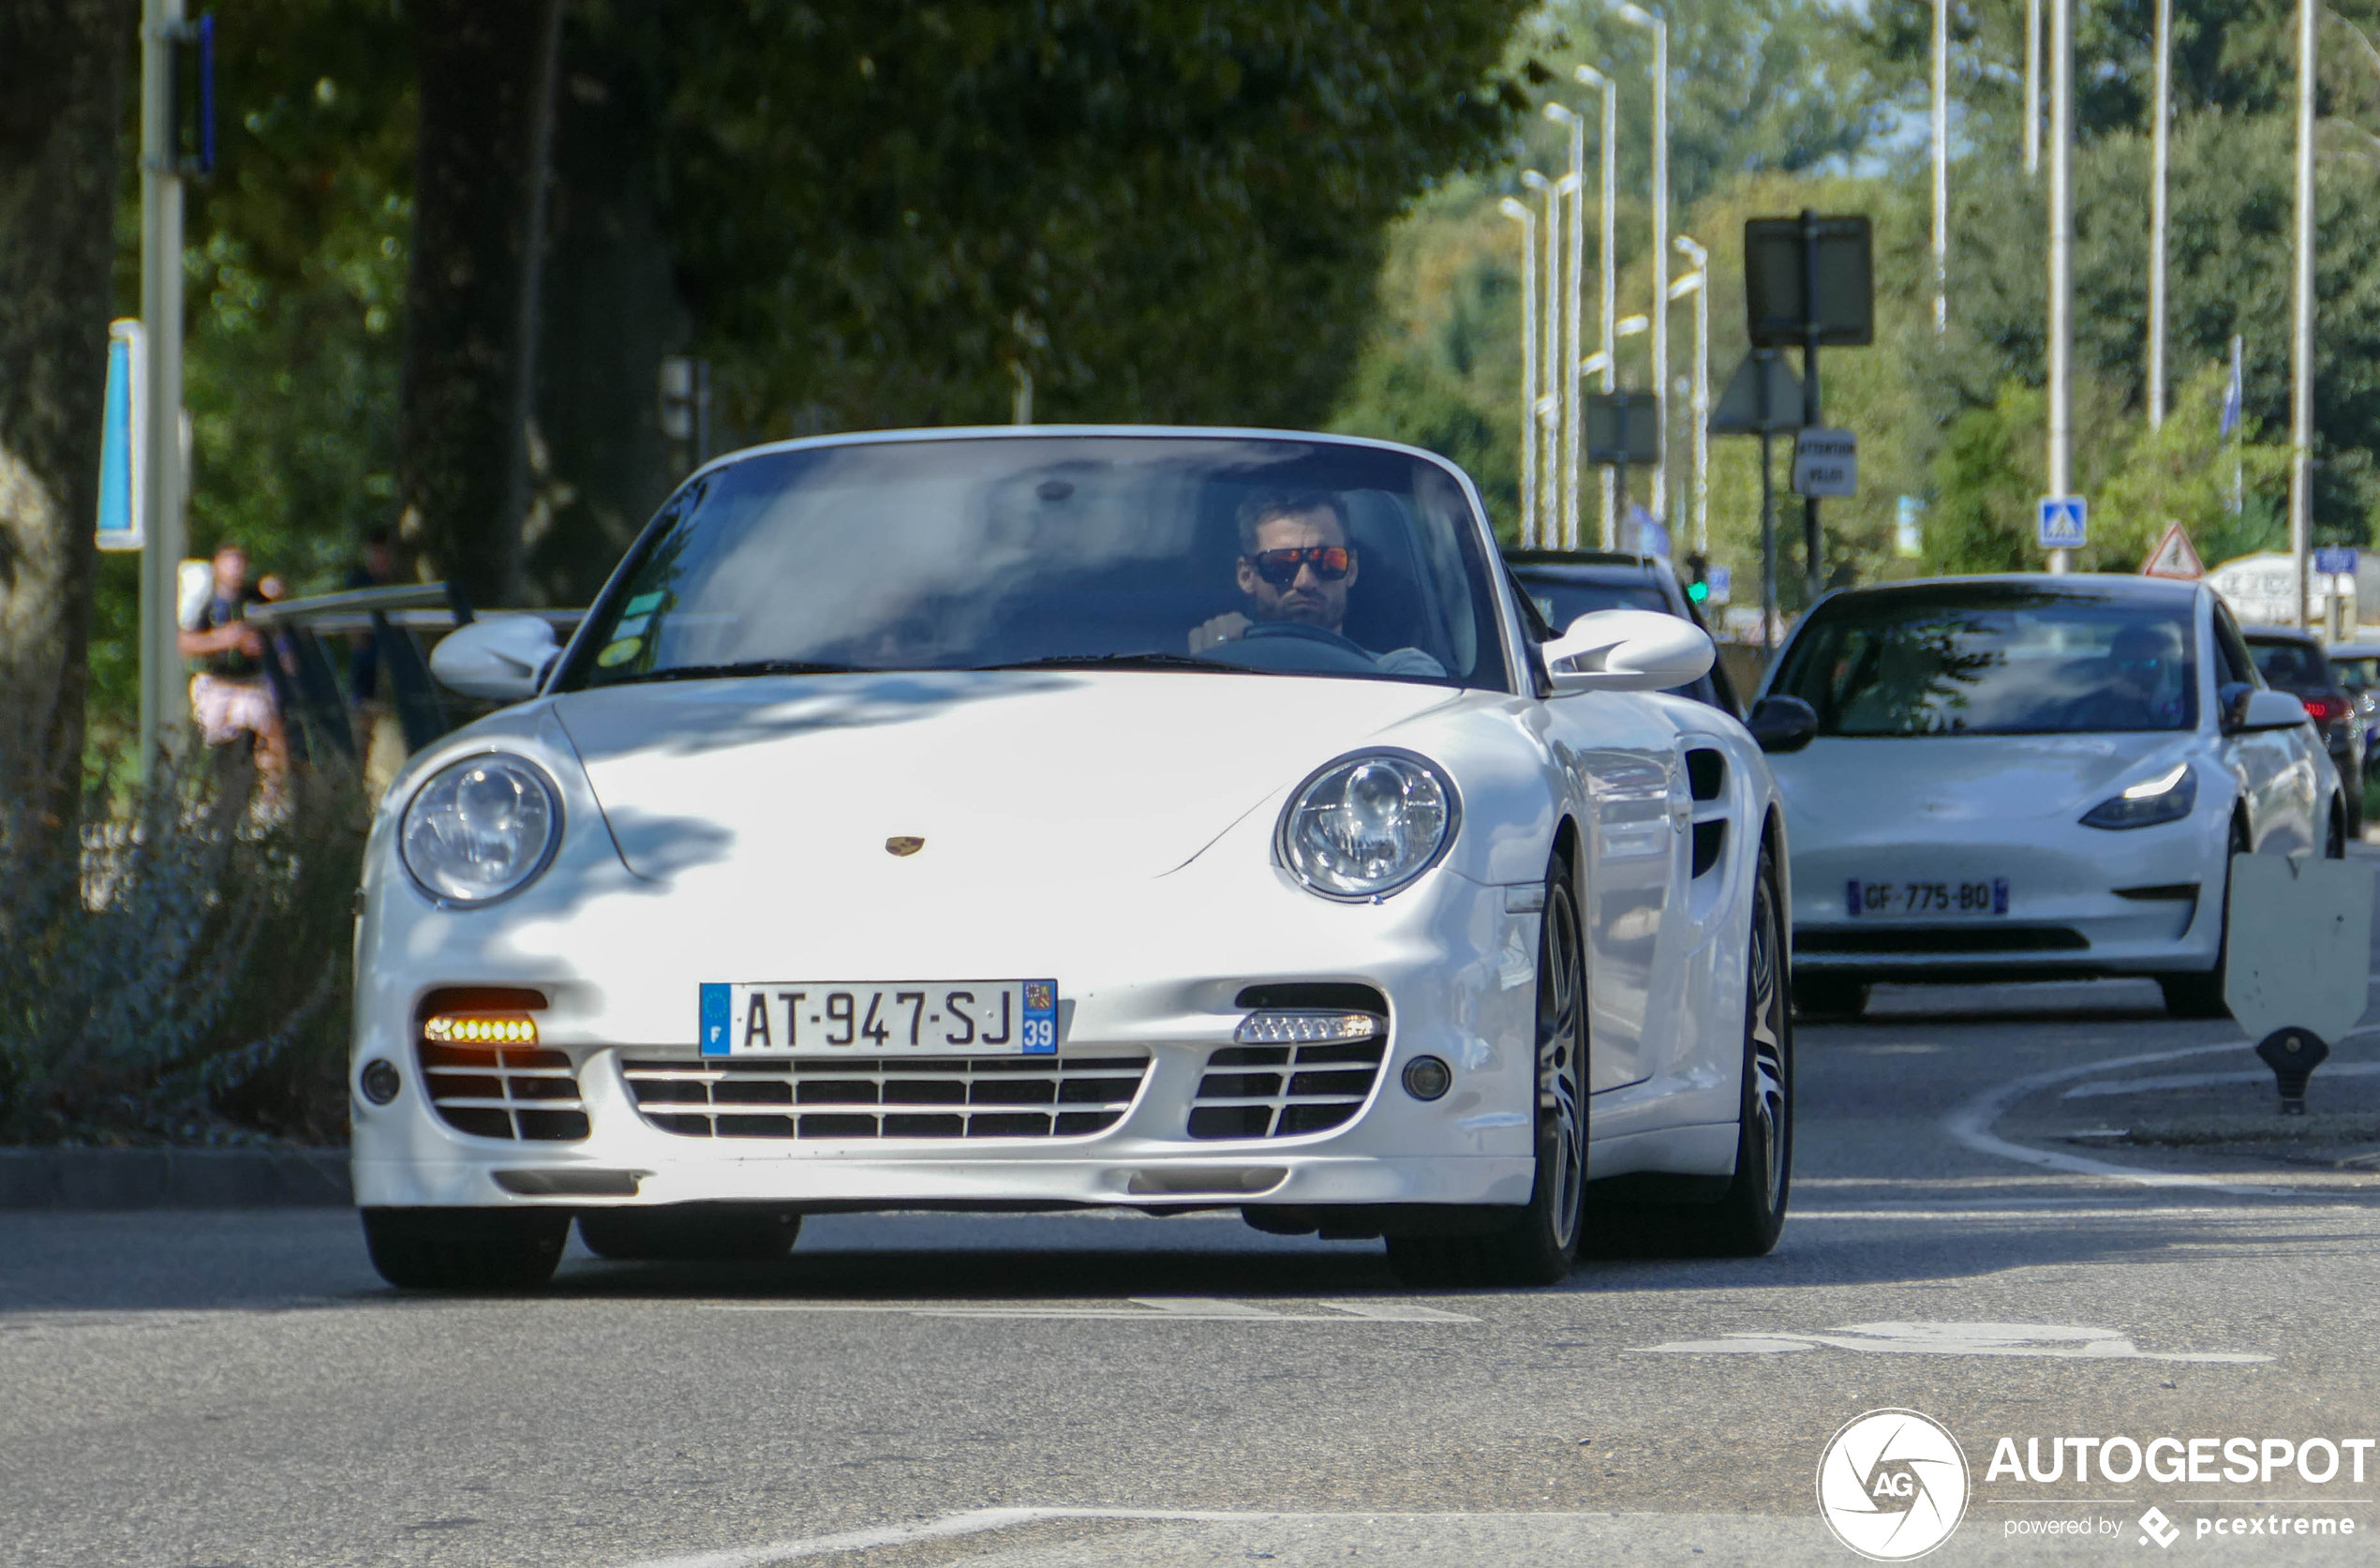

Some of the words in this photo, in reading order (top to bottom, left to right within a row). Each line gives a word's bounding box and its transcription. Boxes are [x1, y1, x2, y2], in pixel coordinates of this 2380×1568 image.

[1798, 441, 1855, 455] ATTENTION
[710, 1026, 722, 1043] F
[744, 991, 1011, 1047] AT-947-SJ
[1024, 1019, 1053, 1047] 39
